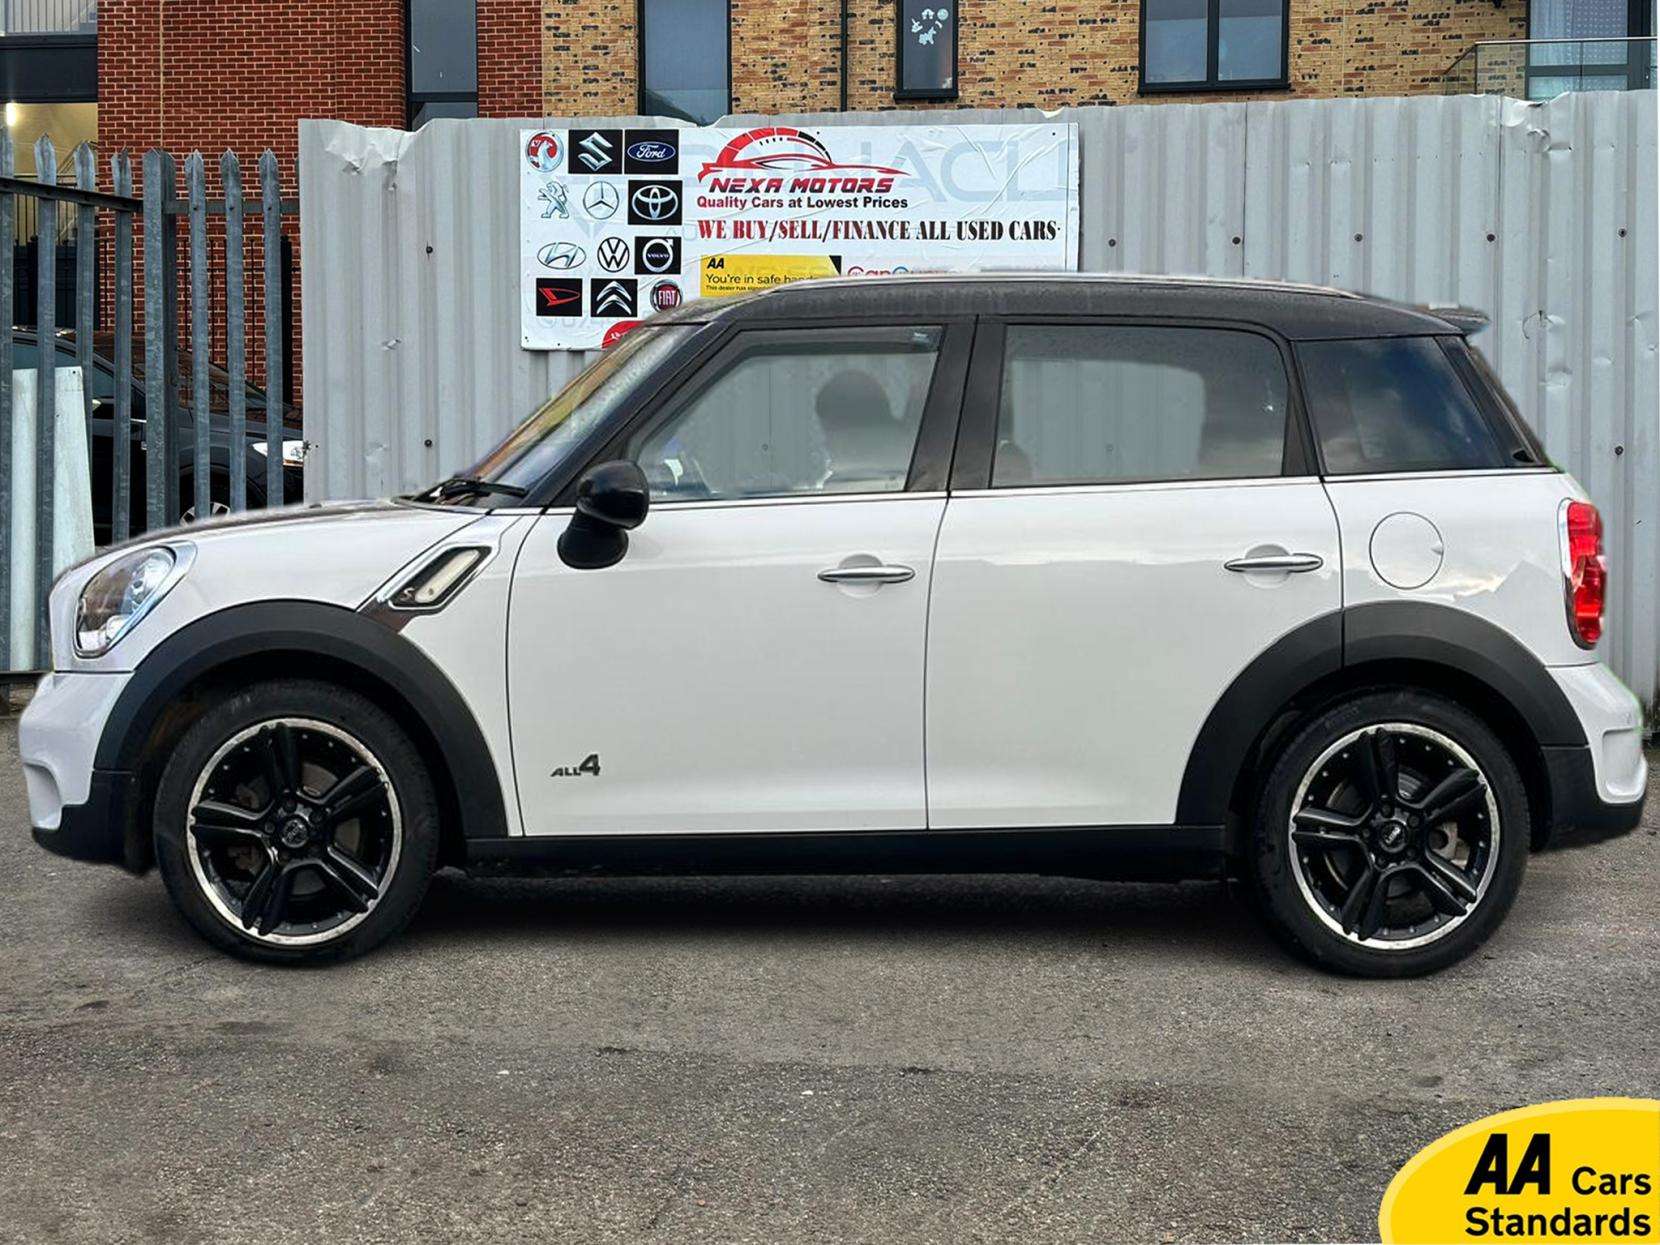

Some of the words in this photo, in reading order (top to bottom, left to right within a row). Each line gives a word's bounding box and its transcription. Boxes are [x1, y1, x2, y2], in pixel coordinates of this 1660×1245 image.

[636, 144, 666, 159] Ford
[709, 177, 784, 194] NEXA
[789, 177, 895, 194] MOTORS
[697, 195, 747, 210] Quality
[751, 196, 784, 208] Cars
[788, 196, 803, 208] at
[807, 196, 859, 208] Lowest
[863, 196, 909, 208] Prices
[697, 219, 727, 240] WE
[916, 220, 951, 241] ALL
[956, 220, 1005, 241] USED
[1008, 220, 1057, 241] CARS
[706, 257, 725, 270] AA
[706, 273, 741, 284] You're
[743, 273, 755, 284] in
[757, 273, 781, 285] safe
[658, 290, 676, 306] FIAT
